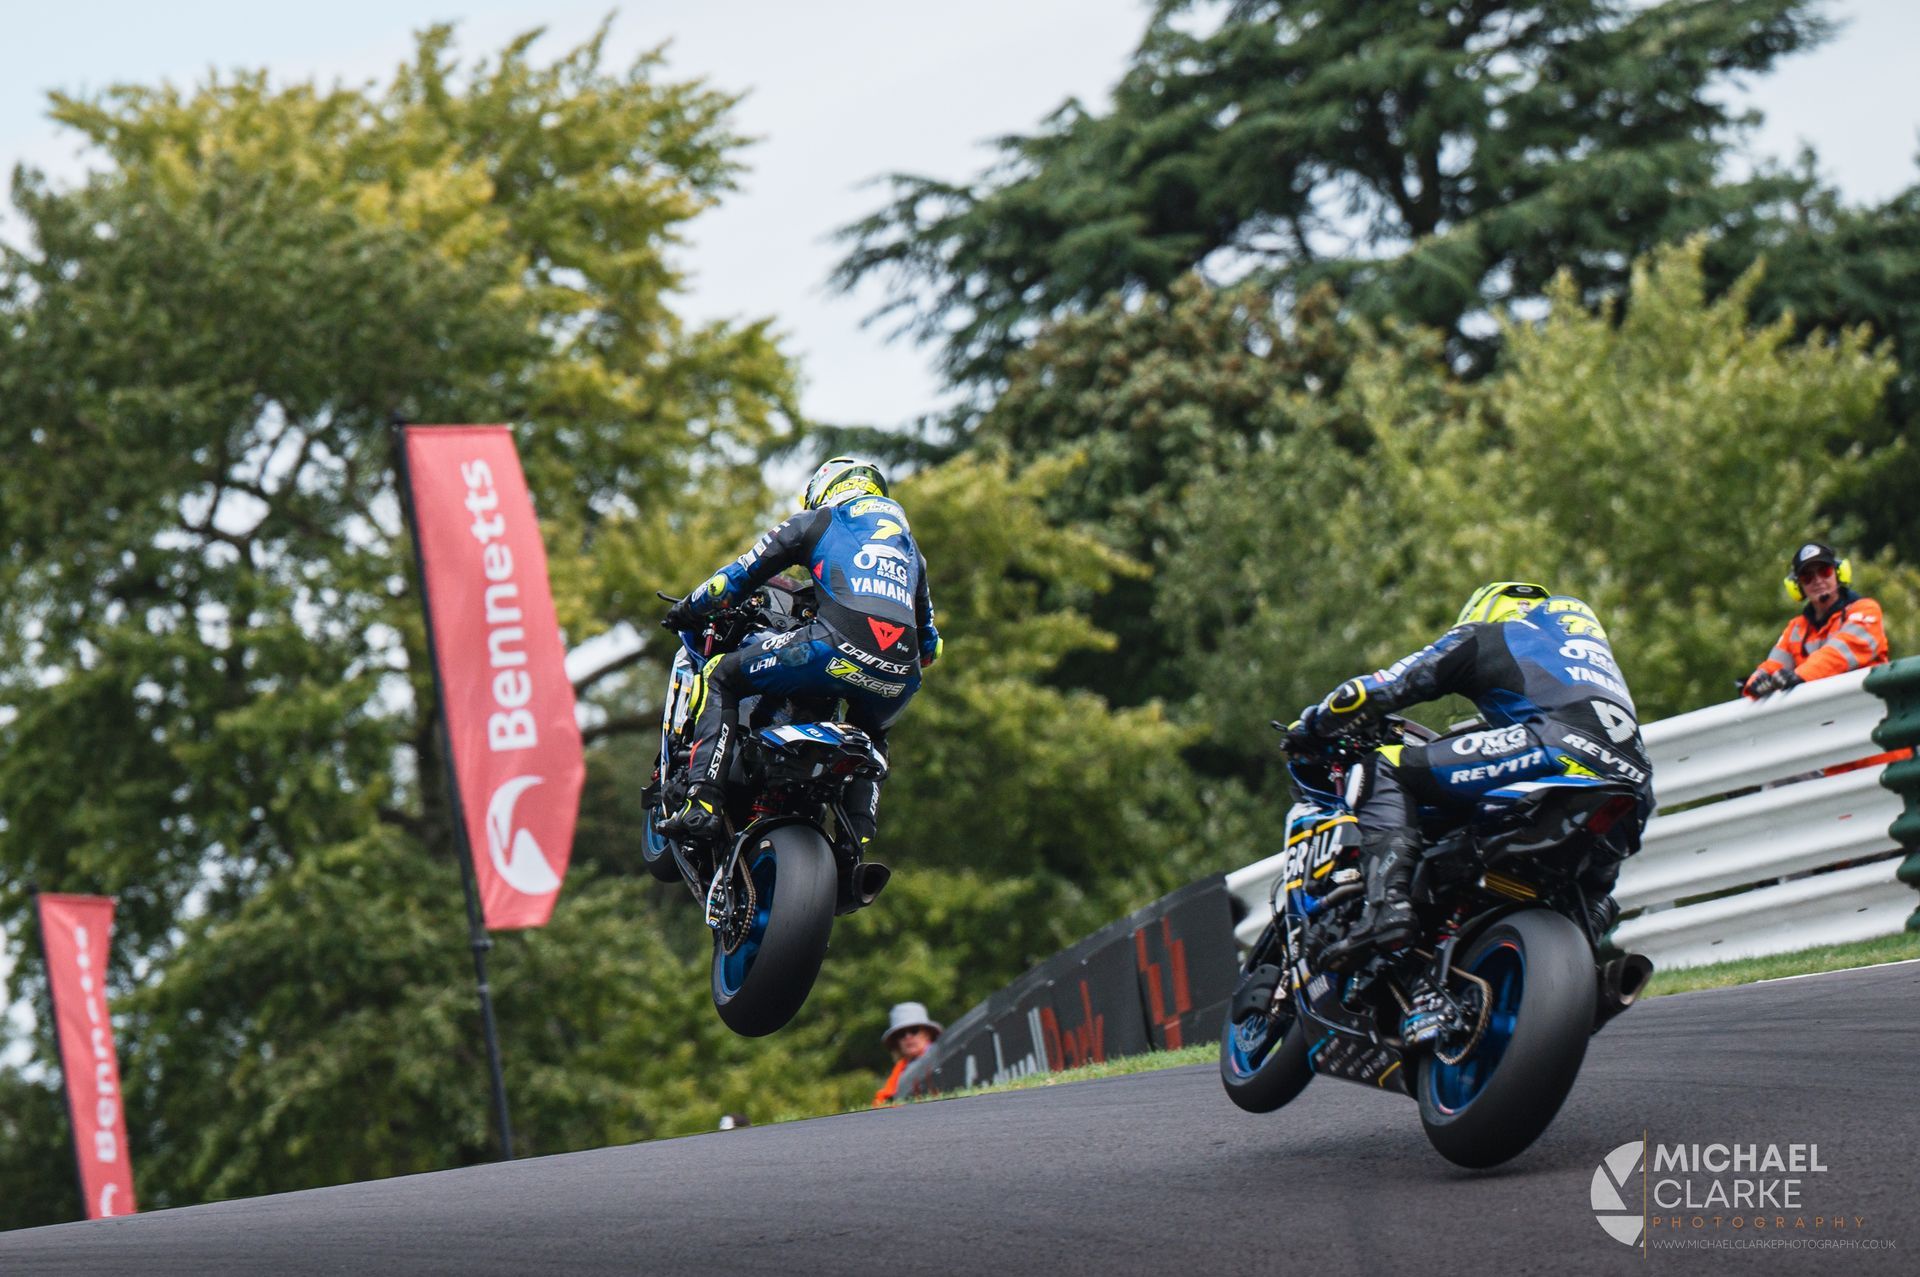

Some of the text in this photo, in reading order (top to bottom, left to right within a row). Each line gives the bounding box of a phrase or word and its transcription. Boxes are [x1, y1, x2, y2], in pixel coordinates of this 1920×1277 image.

[871, 518, 902, 540] 7
[461, 458, 538, 752] Bennetts
[851, 577, 913, 610] YAMAHA
[837, 642, 911, 675] DAINESE
[707, 722, 730, 780] DAINESE
